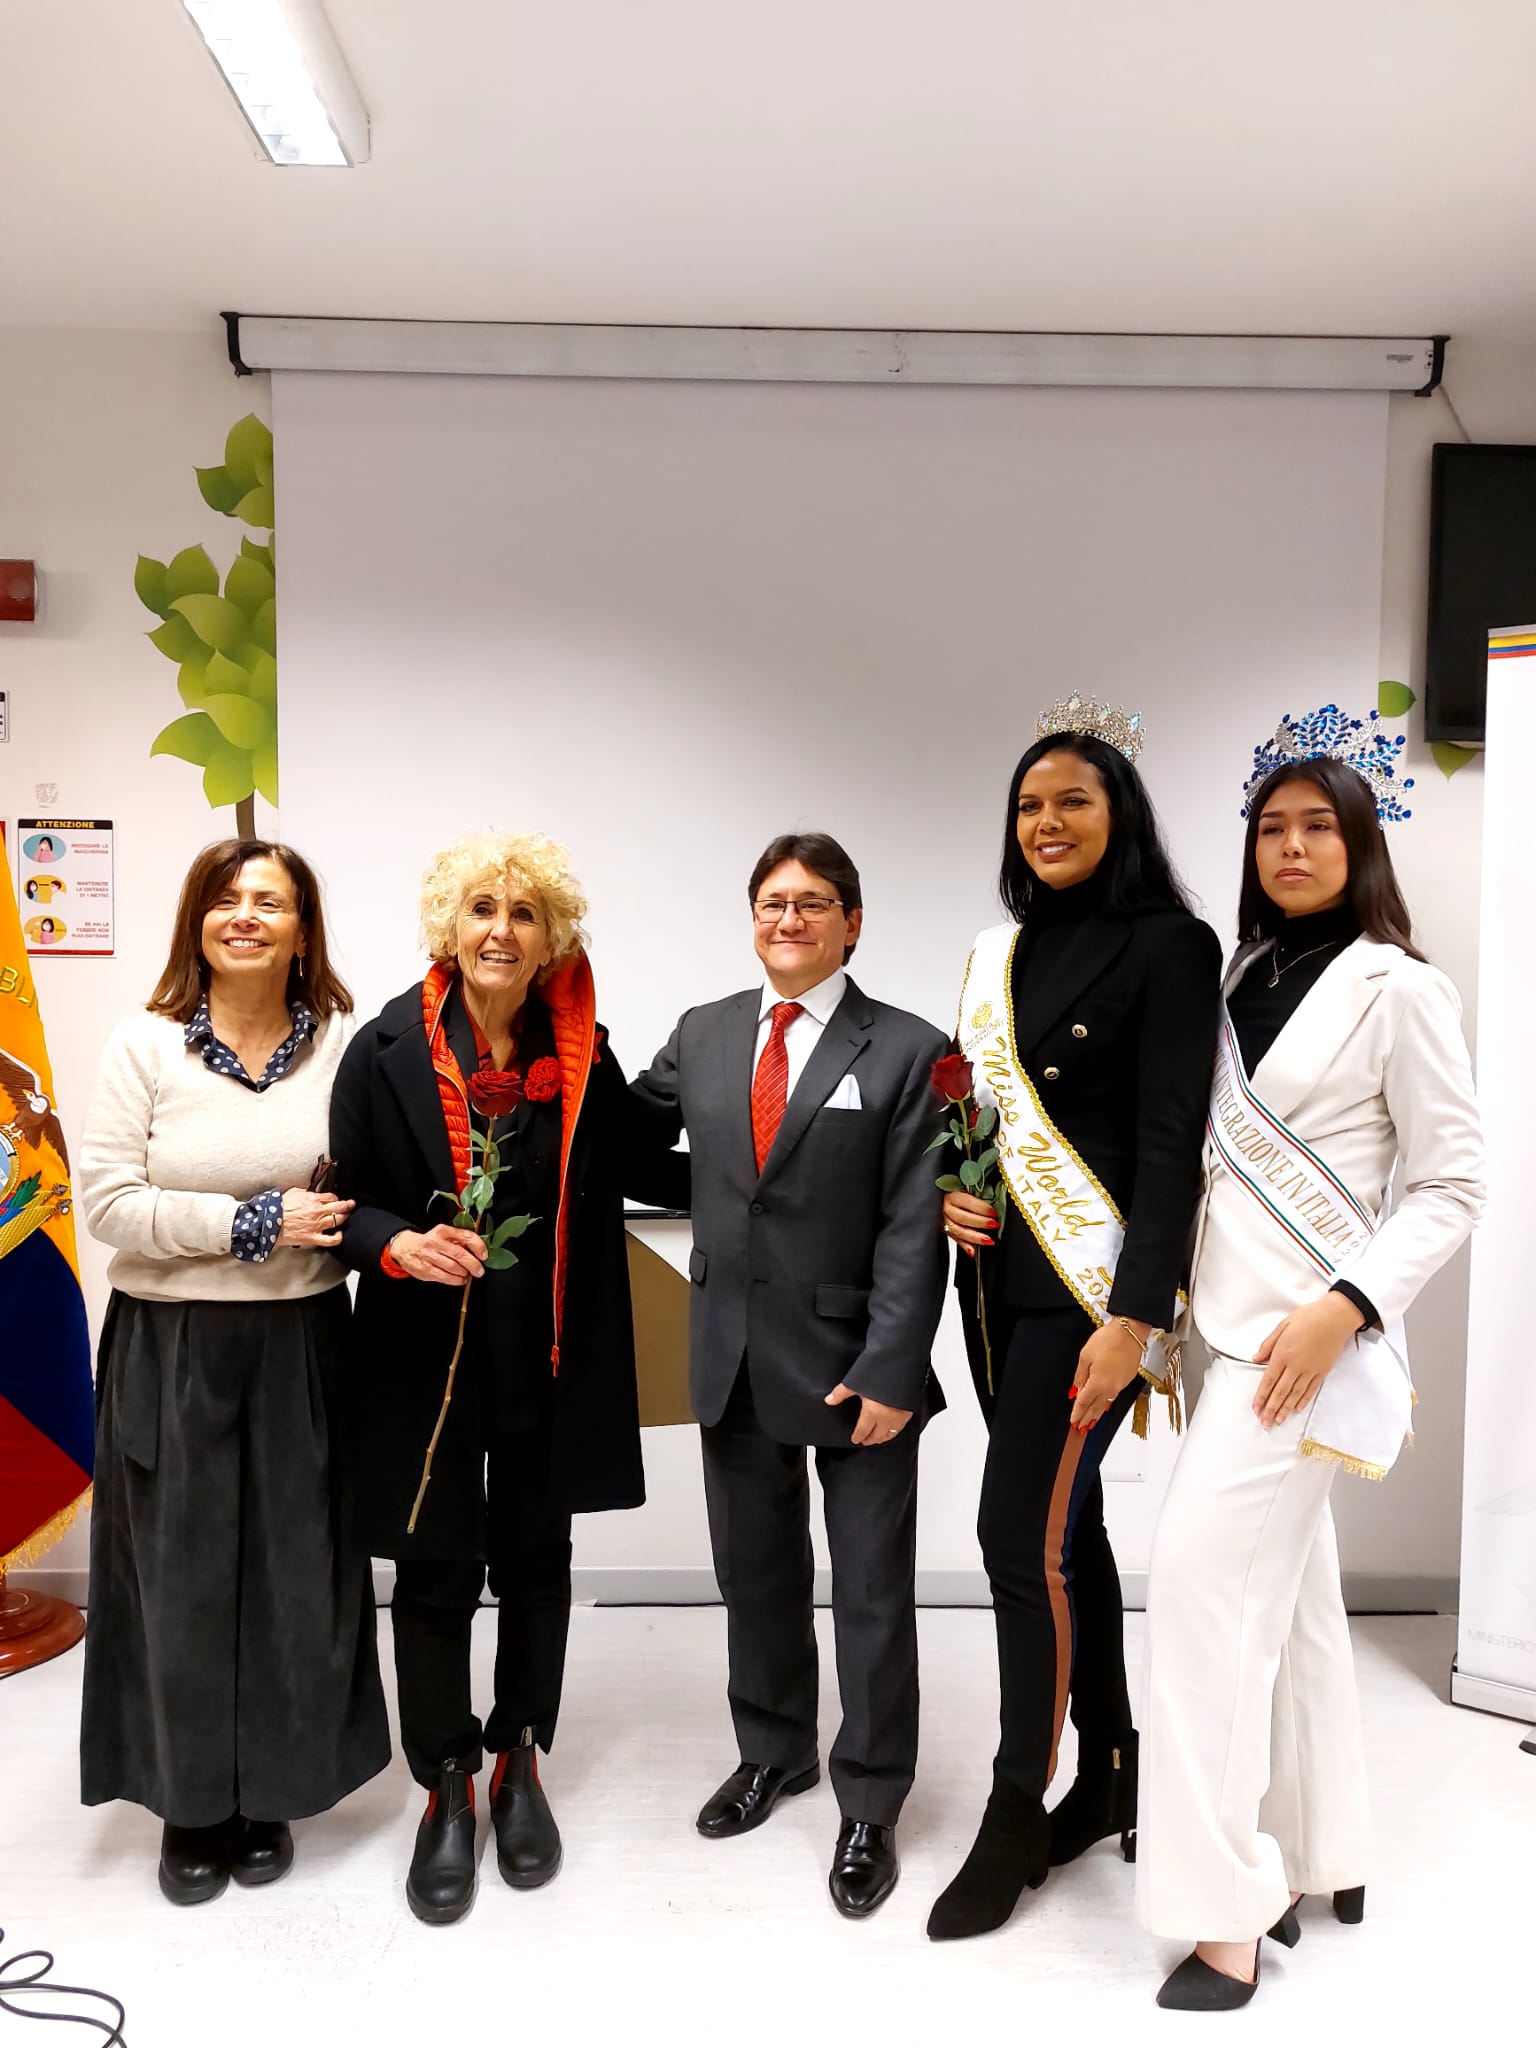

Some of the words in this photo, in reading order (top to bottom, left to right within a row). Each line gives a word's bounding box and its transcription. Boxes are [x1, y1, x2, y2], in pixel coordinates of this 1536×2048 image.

[35, 820, 96, 829] ATTENZIONE
[983, 1036, 1021, 1127] Miss
[1017, 1132, 1106, 1236] World
[1214, 1070, 1295, 1183] INTEGRAZIONE
[996, 1130, 1014, 1159] OF
[1016, 1174, 1068, 1242] ITALY
[1277, 1171, 1314, 1201] IN
[1295, 1190, 1355, 1249] ITALIA
